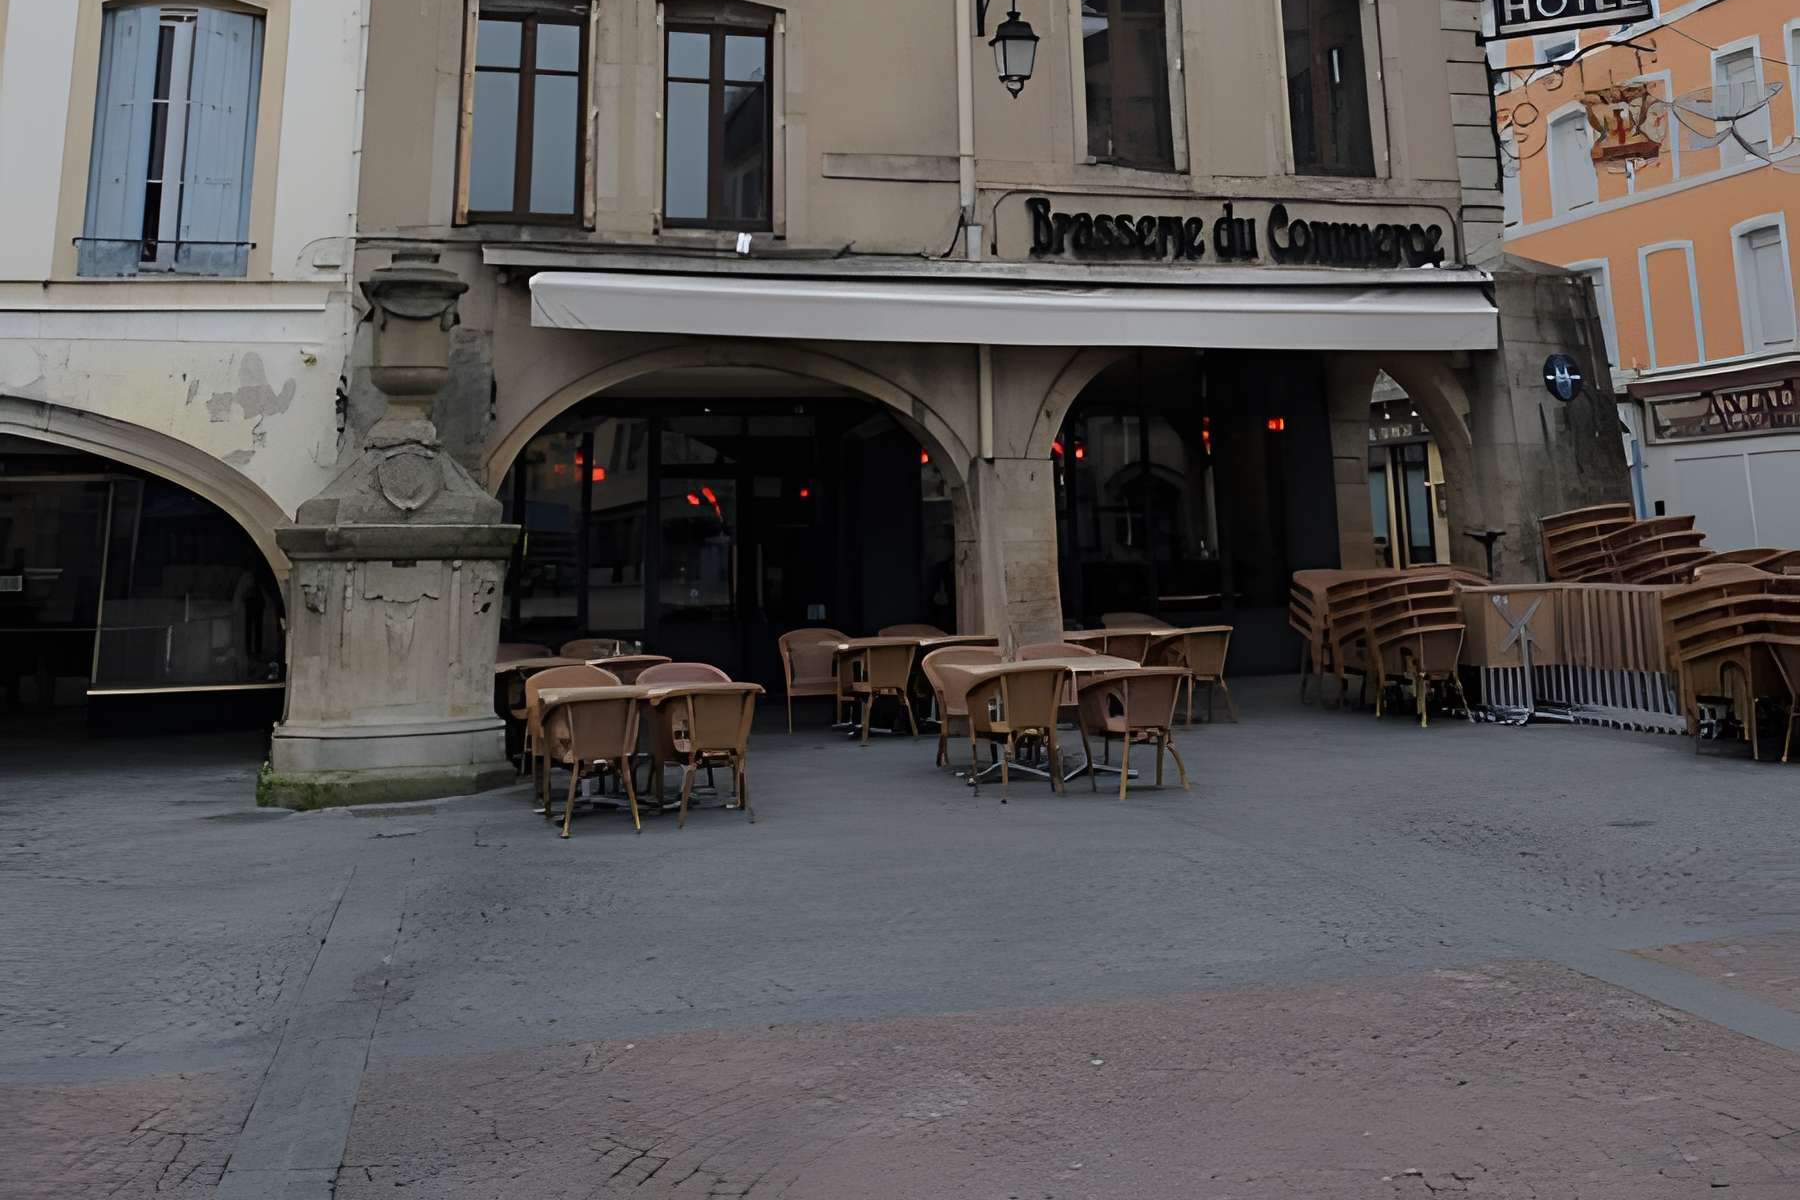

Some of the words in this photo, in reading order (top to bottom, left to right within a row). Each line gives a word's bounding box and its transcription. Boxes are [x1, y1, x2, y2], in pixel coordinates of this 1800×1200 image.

[1025, 197, 1206, 260] Brasserie
[1213, 200, 1259, 260] du
[1268, 203, 1446, 268] Commerce
